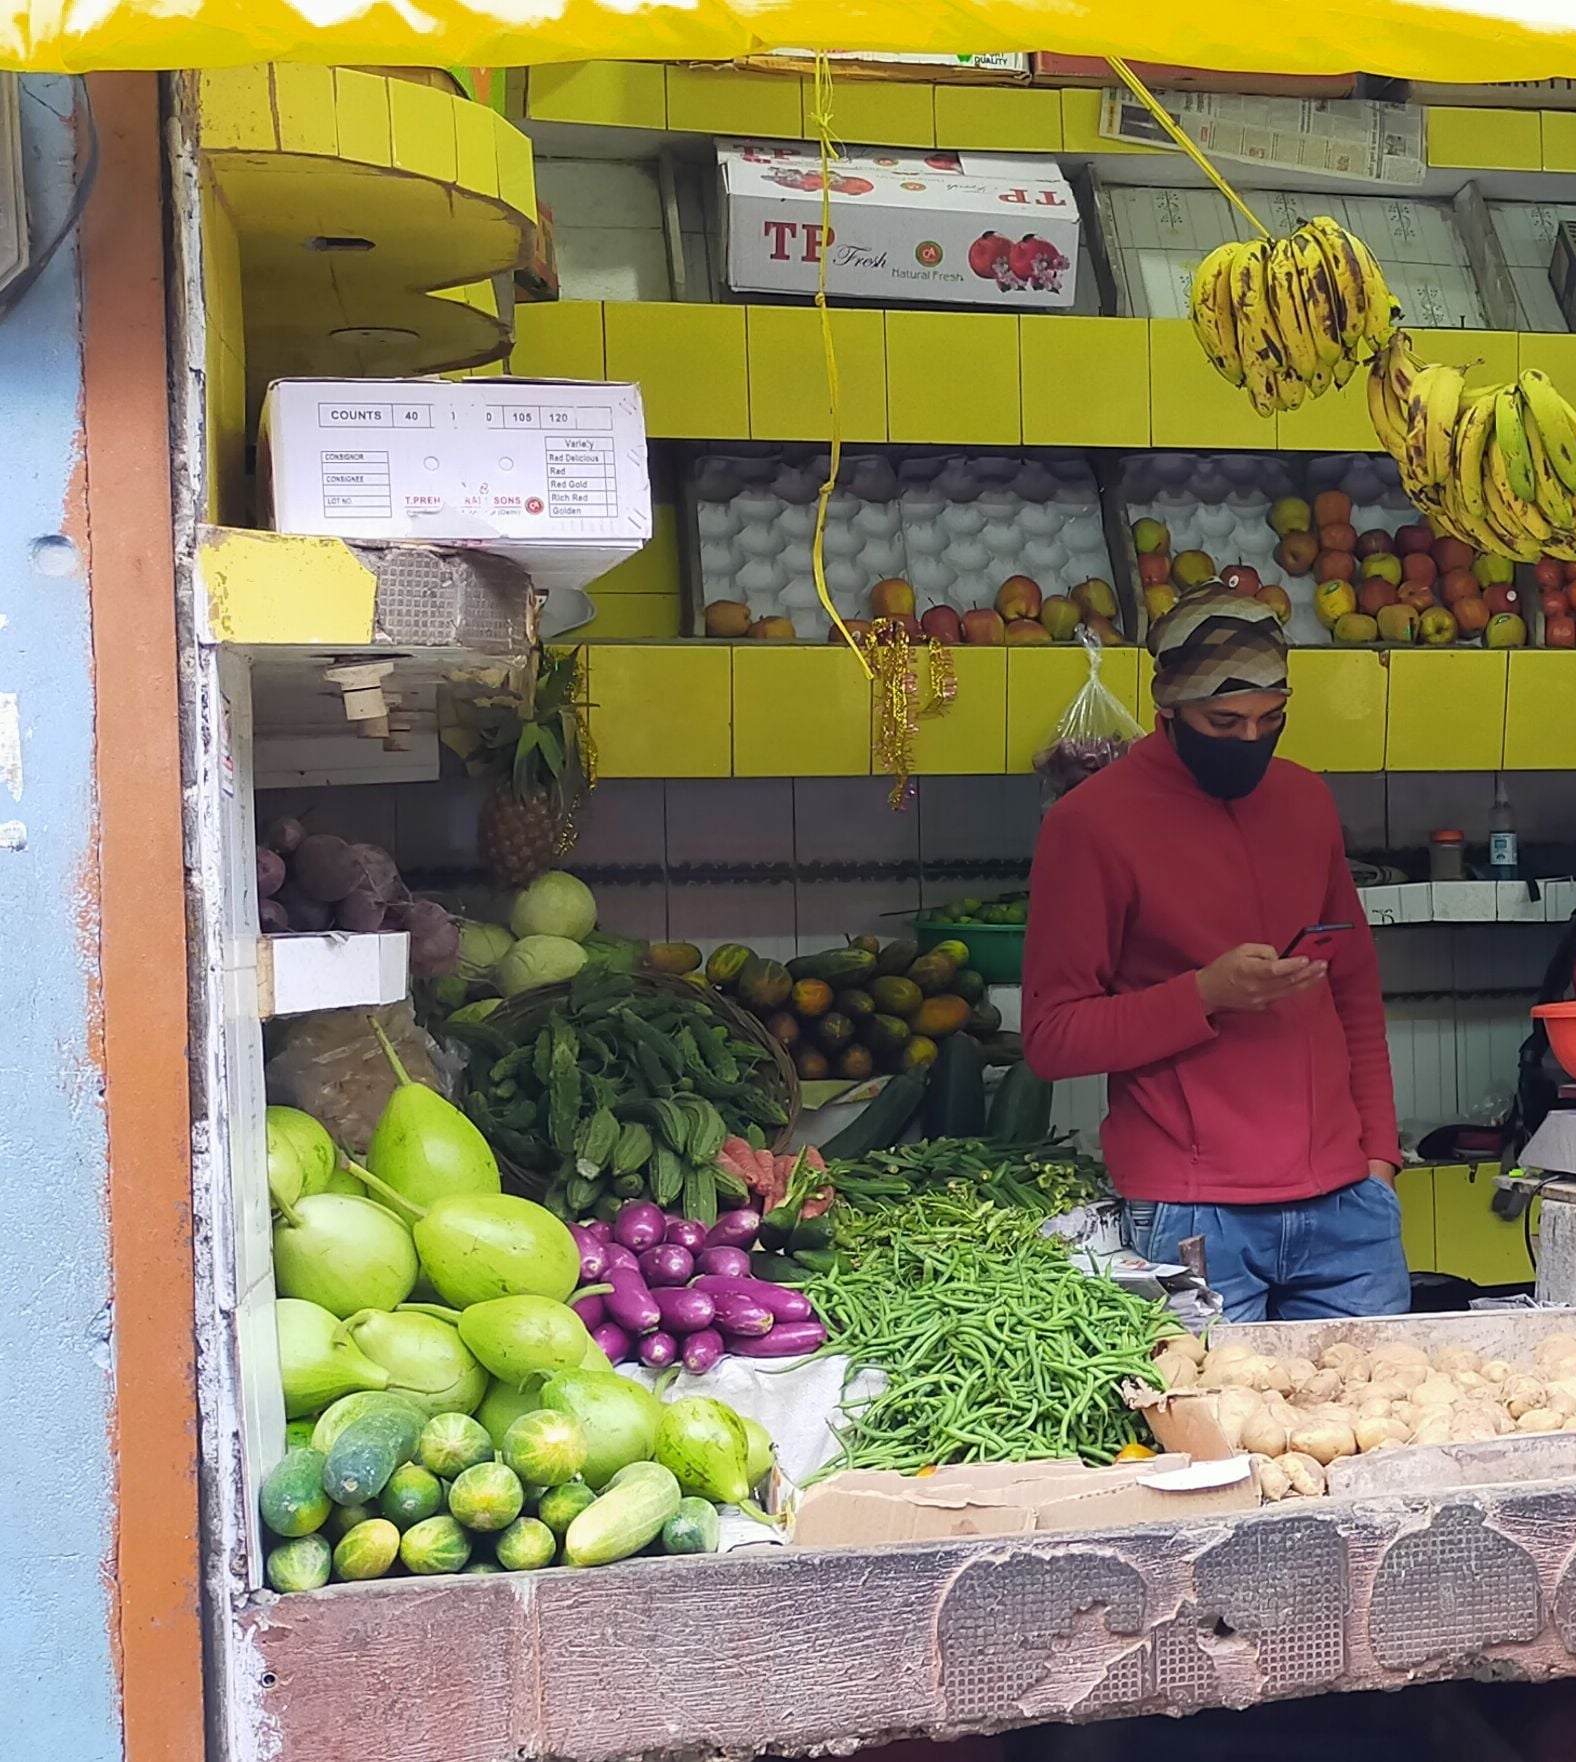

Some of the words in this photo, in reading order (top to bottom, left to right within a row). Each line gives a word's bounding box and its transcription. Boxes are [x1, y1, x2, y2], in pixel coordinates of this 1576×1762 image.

[974, 56, 1007, 65] QUALITY
[764, 220, 836, 263] TP
[832, 244, 888, 269] Fresh
[891, 268, 930, 280] Natural
[932, 271, 961, 283] Fresh
[330, 410, 382, 421] COUNTS
[405, 411, 418, 421] 40
[512, 413, 533, 422] 105
[549, 413, 568, 423] 120
[324, 453, 365, 461] CONSIGNOR
[549, 454, 564, 462] Red
[565, 454, 599, 463] Delicious
[550, 467, 566, 475] Red
[550, 480, 566, 489] Red
[568, 480, 588, 489] Gold
[493, 496, 522, 505] SONS
[551, 494, 570, 502] Rich
[572, 494, 589, 502] Red
[552, 507, 582, 515] Golden
